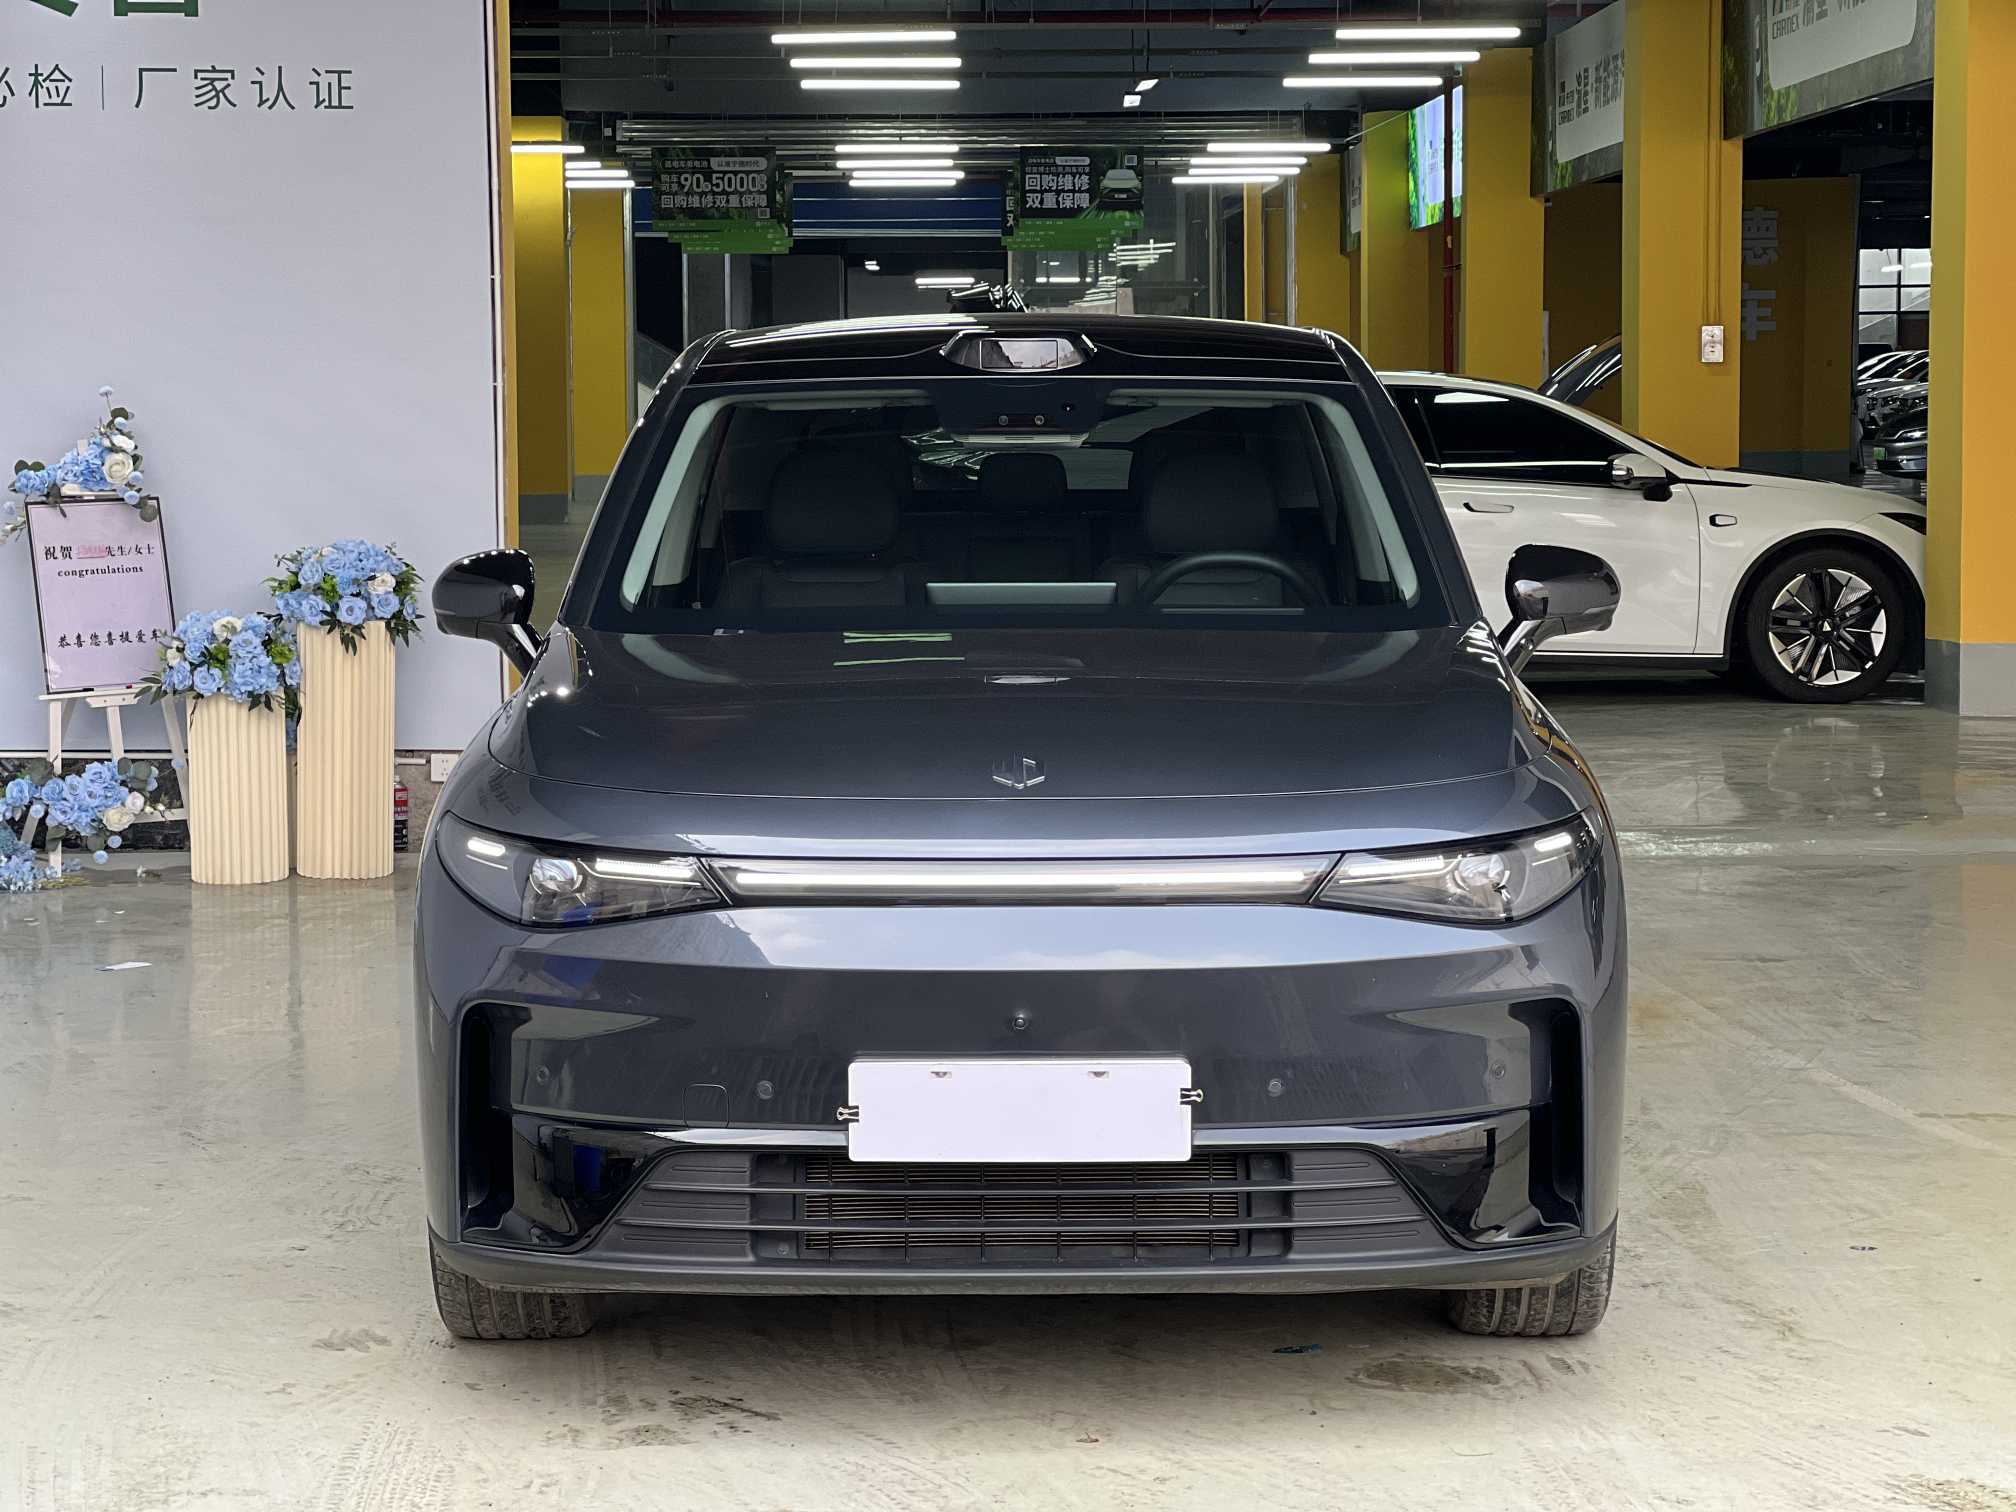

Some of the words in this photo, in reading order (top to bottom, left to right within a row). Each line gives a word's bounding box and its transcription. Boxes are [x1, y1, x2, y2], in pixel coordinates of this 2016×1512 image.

[134, 65, 355, 110] 厂家认证
[1025, 174, 1090, 191] 回购维修
[661, 194, 768, 208] 回购维修双重保障
[1025, 192, 1090, 209] 双重保障
[44, 545, 73, 560] 祝贺
[57, 564, 144, 578] congratulations
[58, 628, 161, 648] 恭喜您喜提爱车
